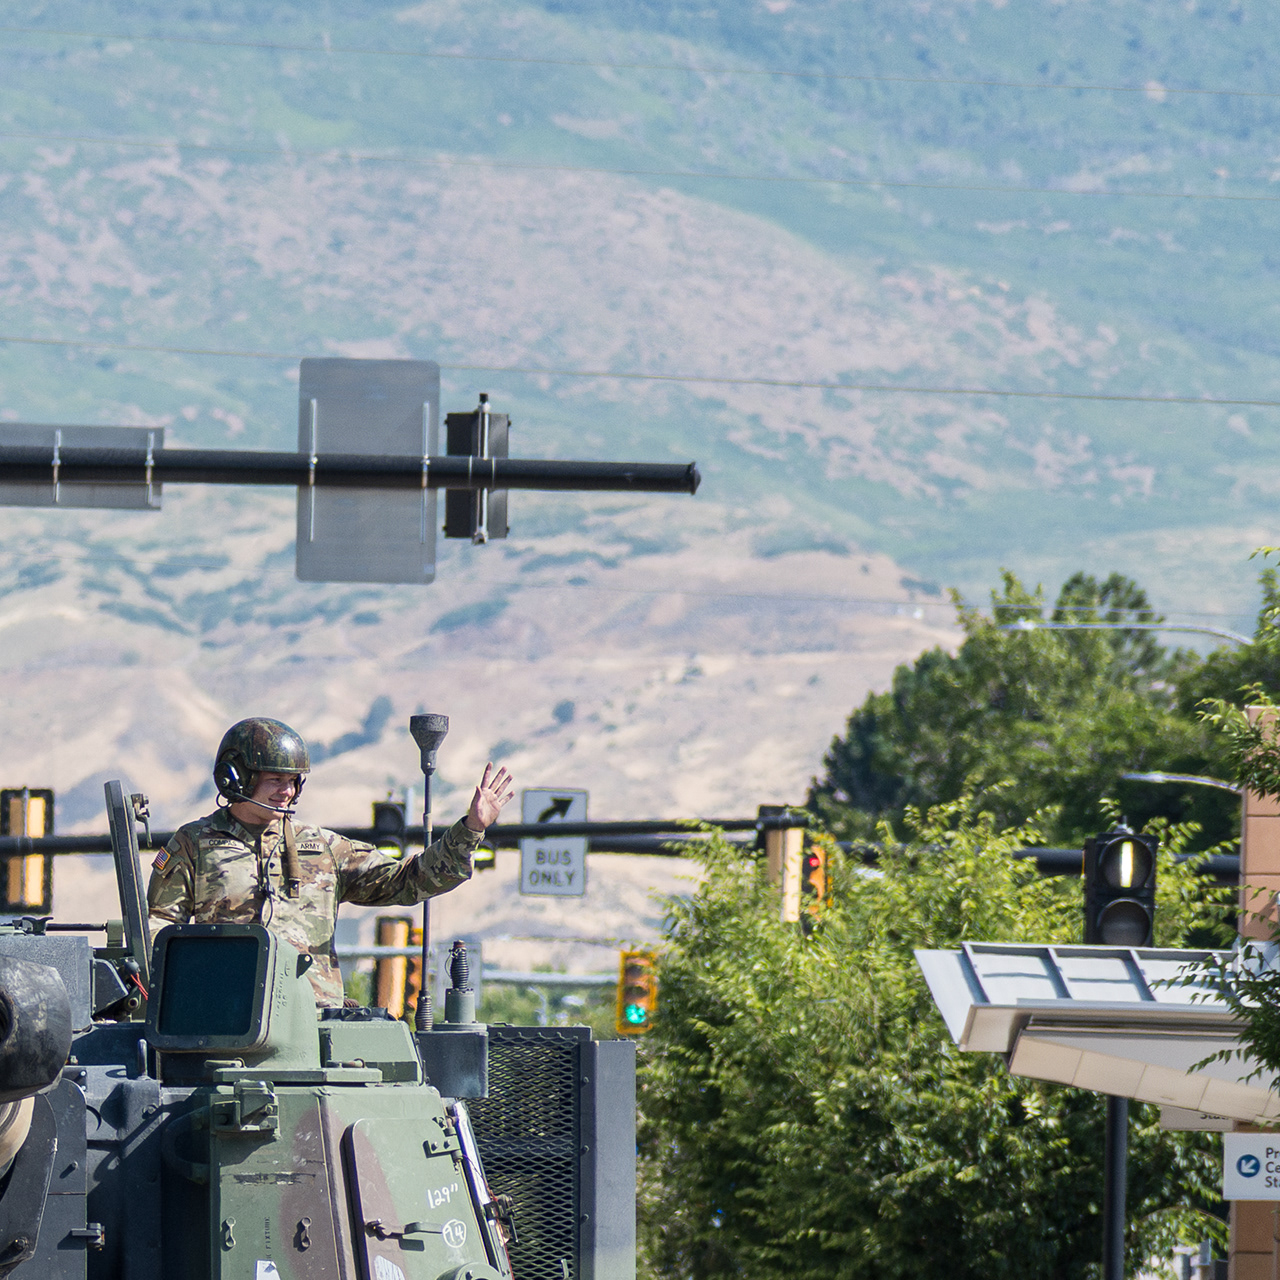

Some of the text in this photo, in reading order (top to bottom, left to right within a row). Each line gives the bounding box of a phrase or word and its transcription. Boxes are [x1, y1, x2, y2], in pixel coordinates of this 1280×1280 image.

[300, 842, 320, 850] ARMY
[535, 849, 572, 865] BUS
[529, 871, 576, 887] ONLY
[1264, 1176, 1280, 1188] St
